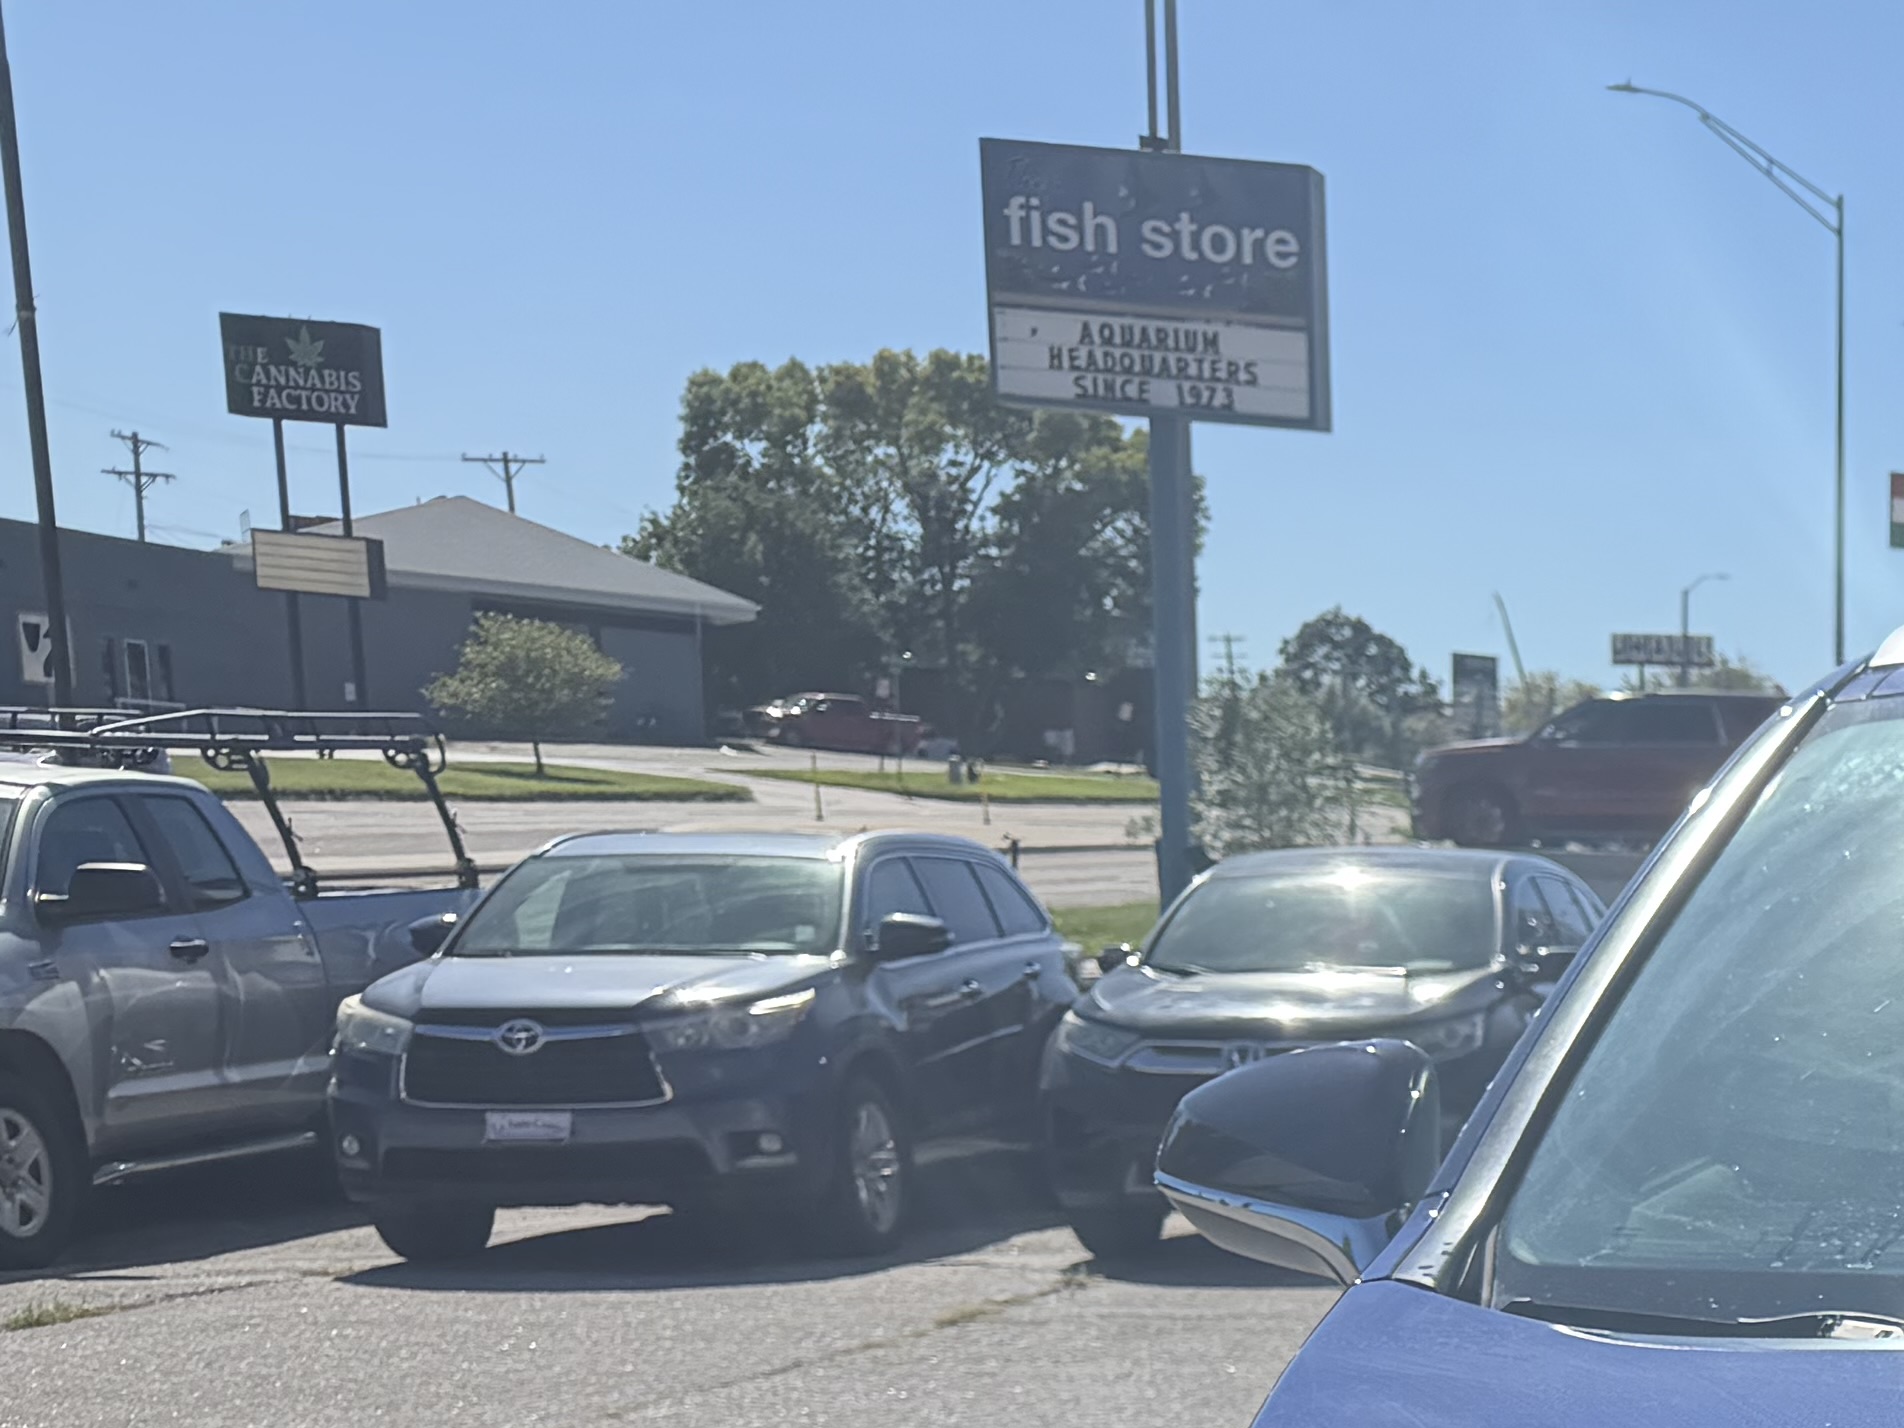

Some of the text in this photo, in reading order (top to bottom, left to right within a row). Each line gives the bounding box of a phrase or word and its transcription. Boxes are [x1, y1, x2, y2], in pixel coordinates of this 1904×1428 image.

[1003, 196, 1301, 269] fish store
[1079, 321, 1220, 354] AQUARIUM
[234, 363, 362, 392] CANNABIS
[1048, 345, 1259, 385] HEADQUARTERS
[251, 386, 360, 414] FACTORY
[1073, 375, 1236, 412] SINCE 1973
